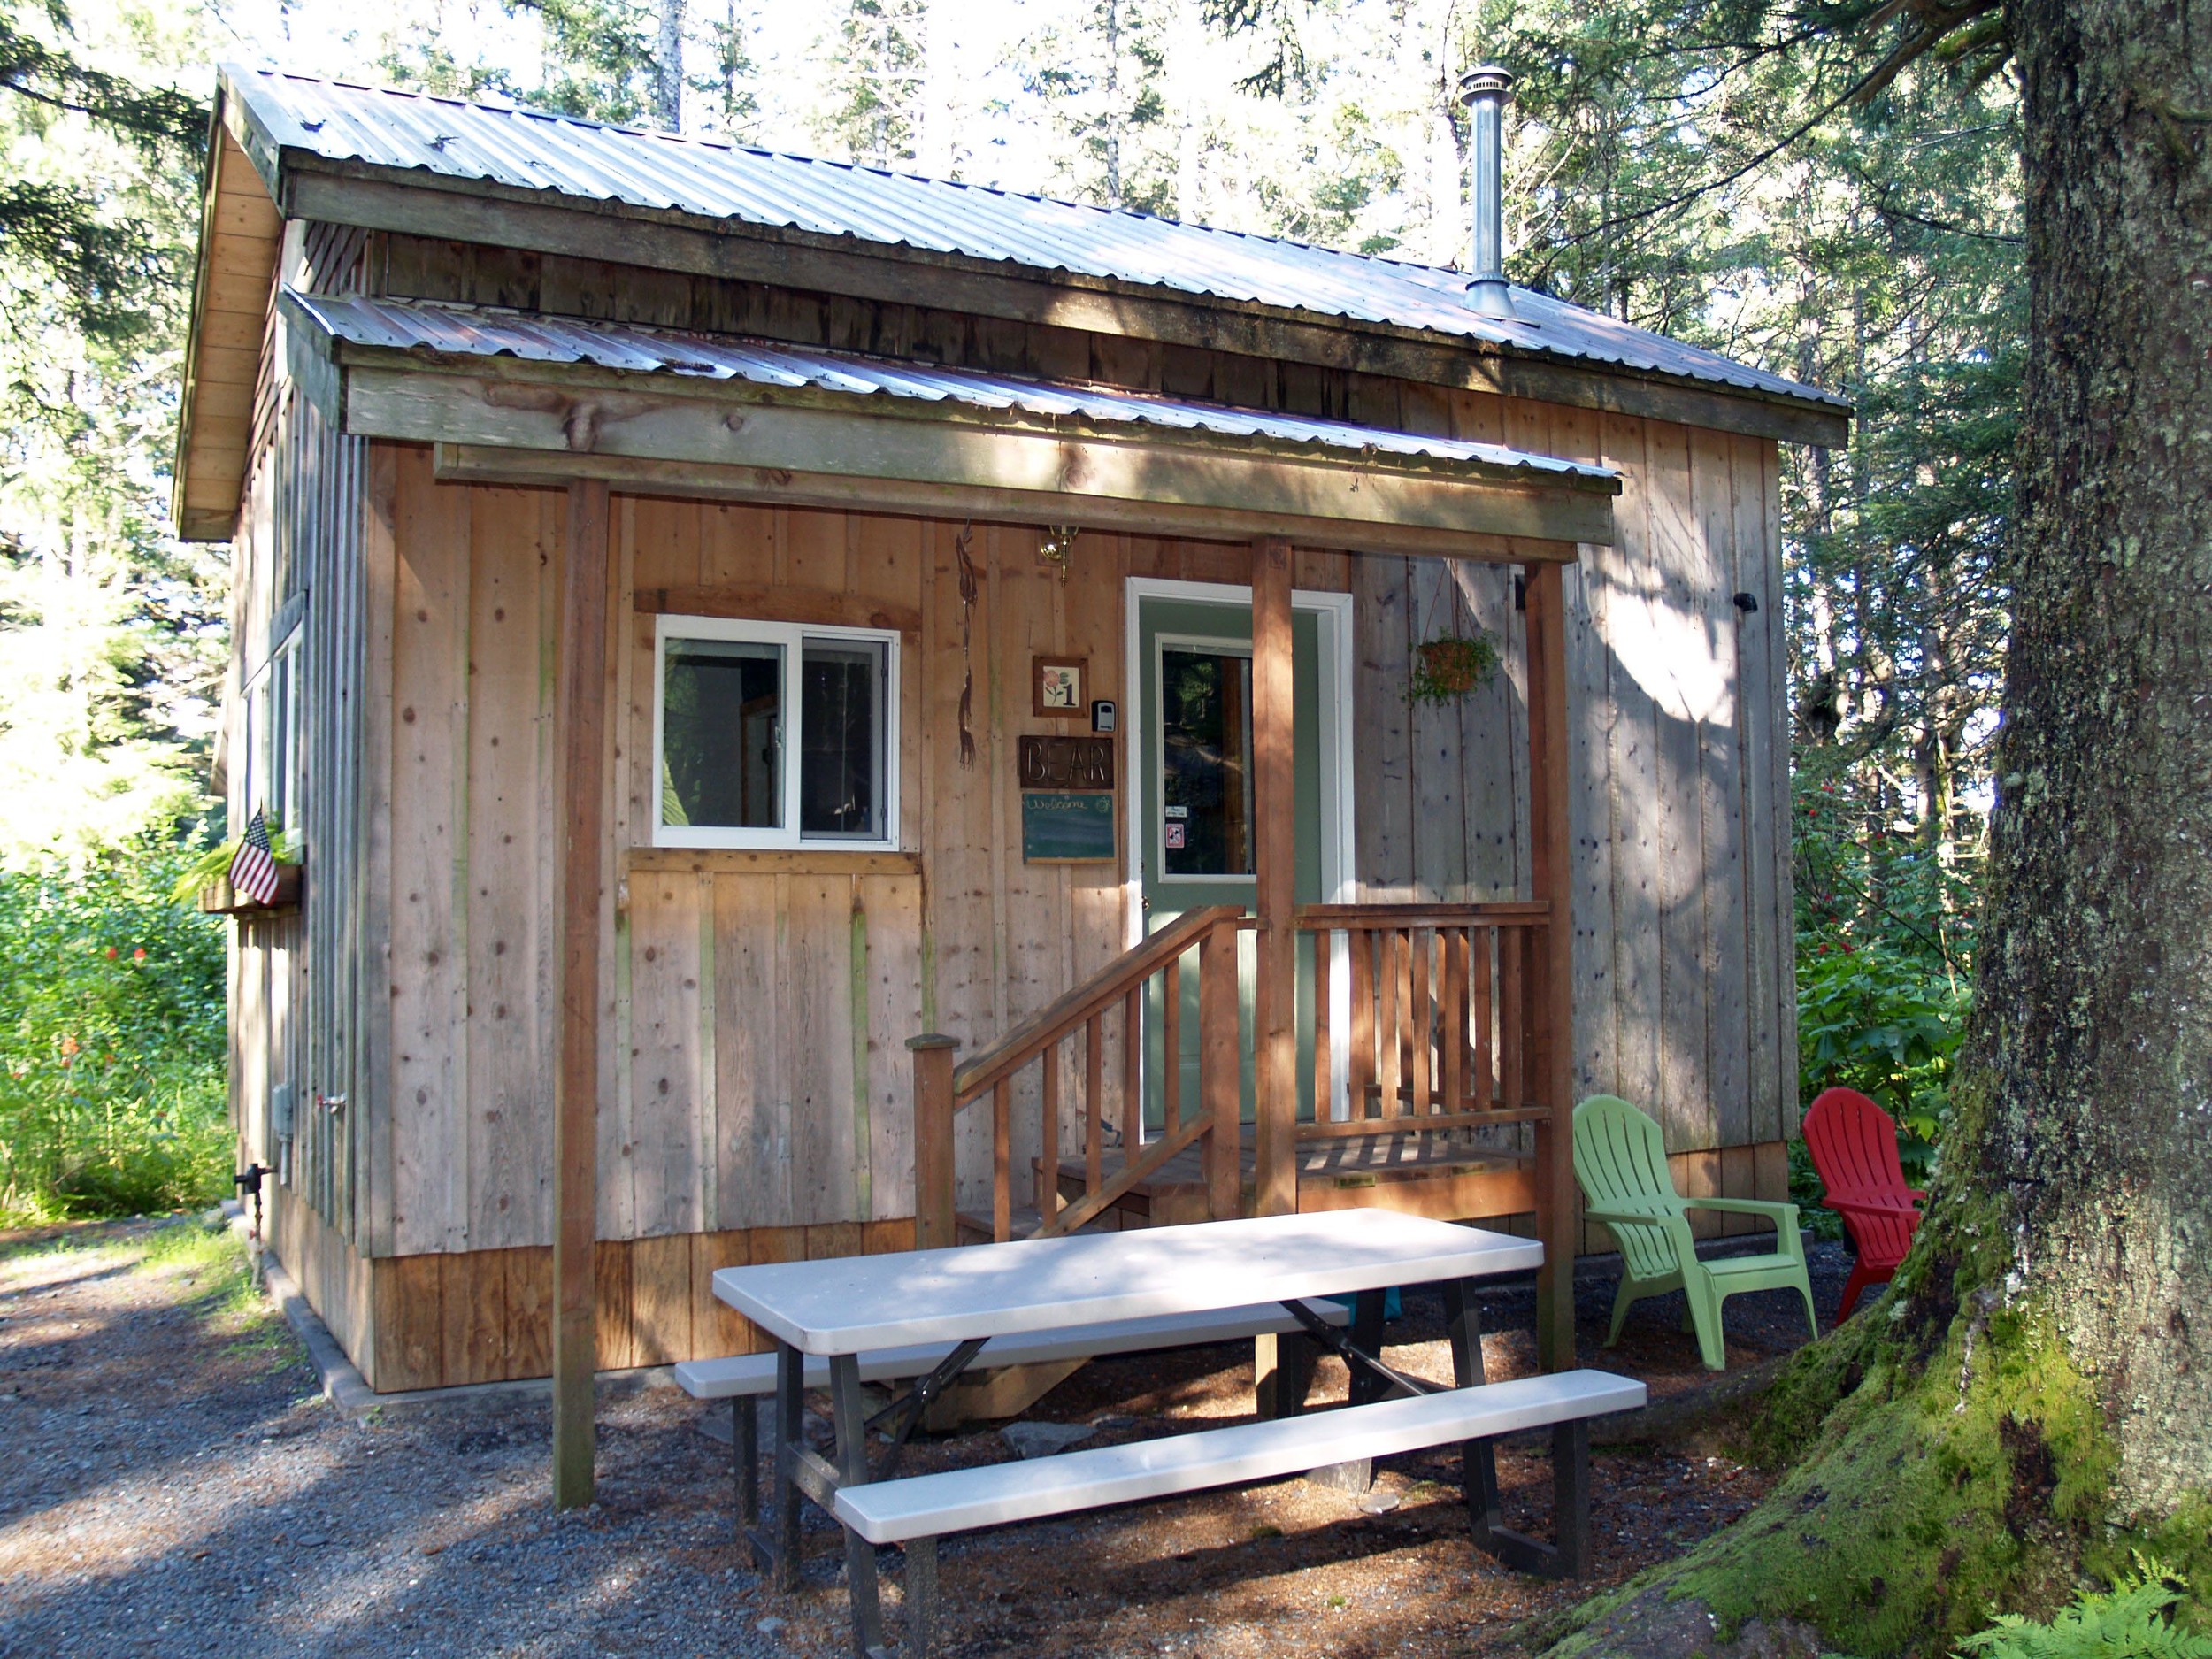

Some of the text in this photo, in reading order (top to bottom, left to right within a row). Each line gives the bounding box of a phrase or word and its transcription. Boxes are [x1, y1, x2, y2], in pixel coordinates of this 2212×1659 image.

[1063, 683, 1076, 706] 1
[1027, 741, 1105, 781] BEAR
[1027, 798, 1088, 811] Welcome
